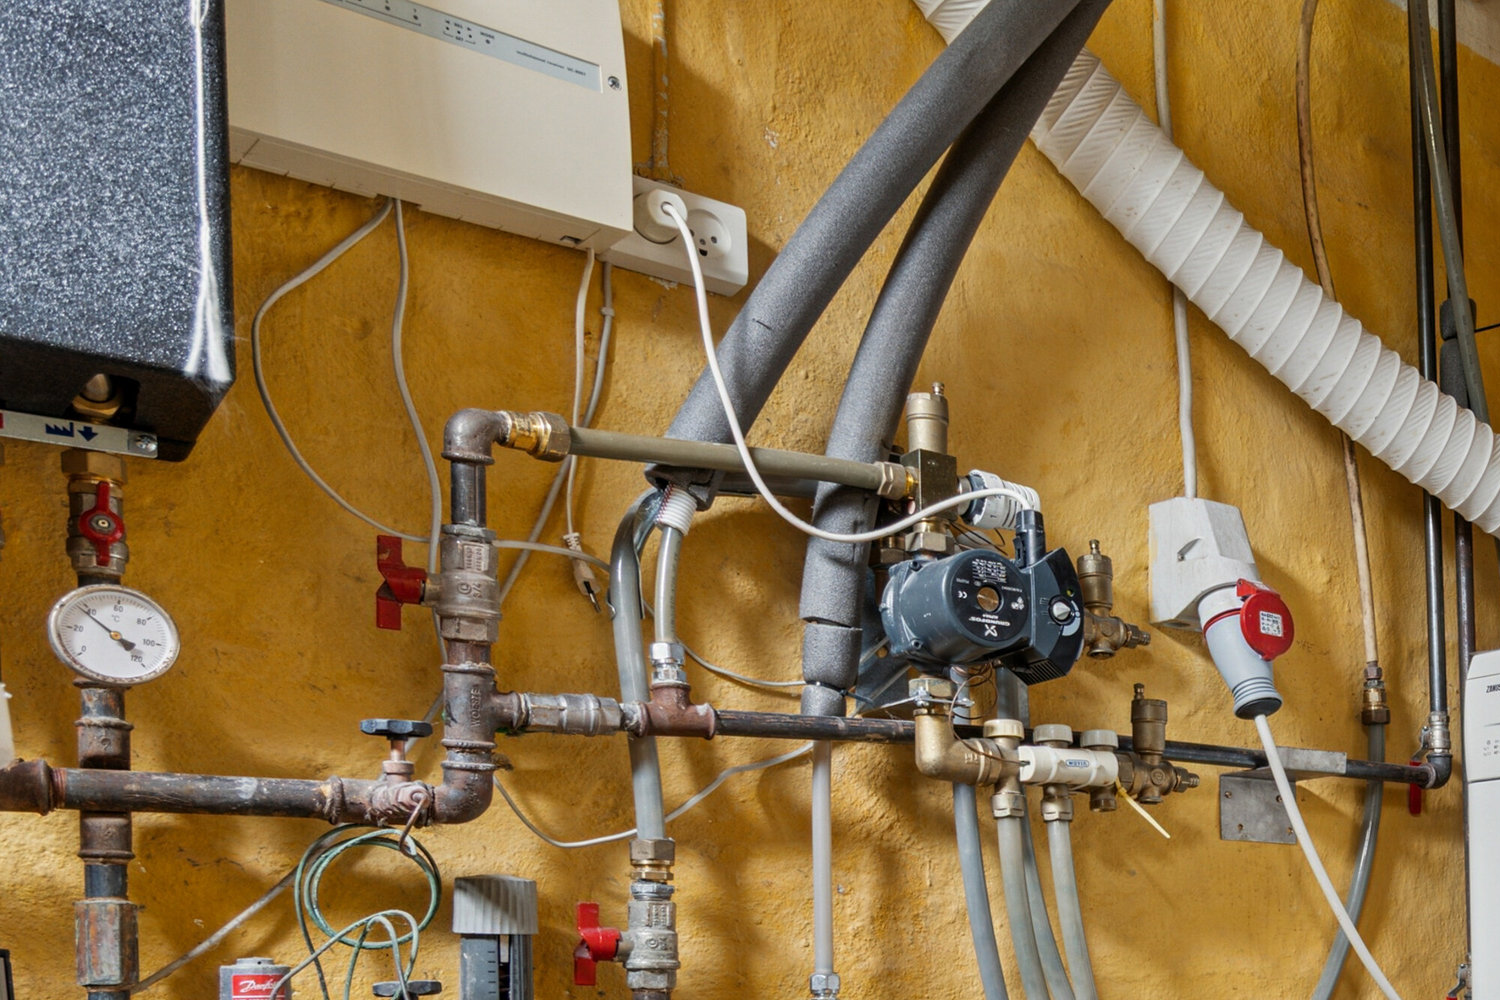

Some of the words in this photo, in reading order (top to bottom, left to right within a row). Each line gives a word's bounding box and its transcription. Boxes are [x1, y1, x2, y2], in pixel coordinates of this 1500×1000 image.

[113, 605, 124, 613] 60
[136, 618, 147, 626] 80
[968, 616, 1011, 627] GRUNDFOS
[73, 624, 84, 632] 20
[143, 639, 156, 647] 100
[130, 655, 143, 663] 120
[239, 979, 281, 993] Danfo
